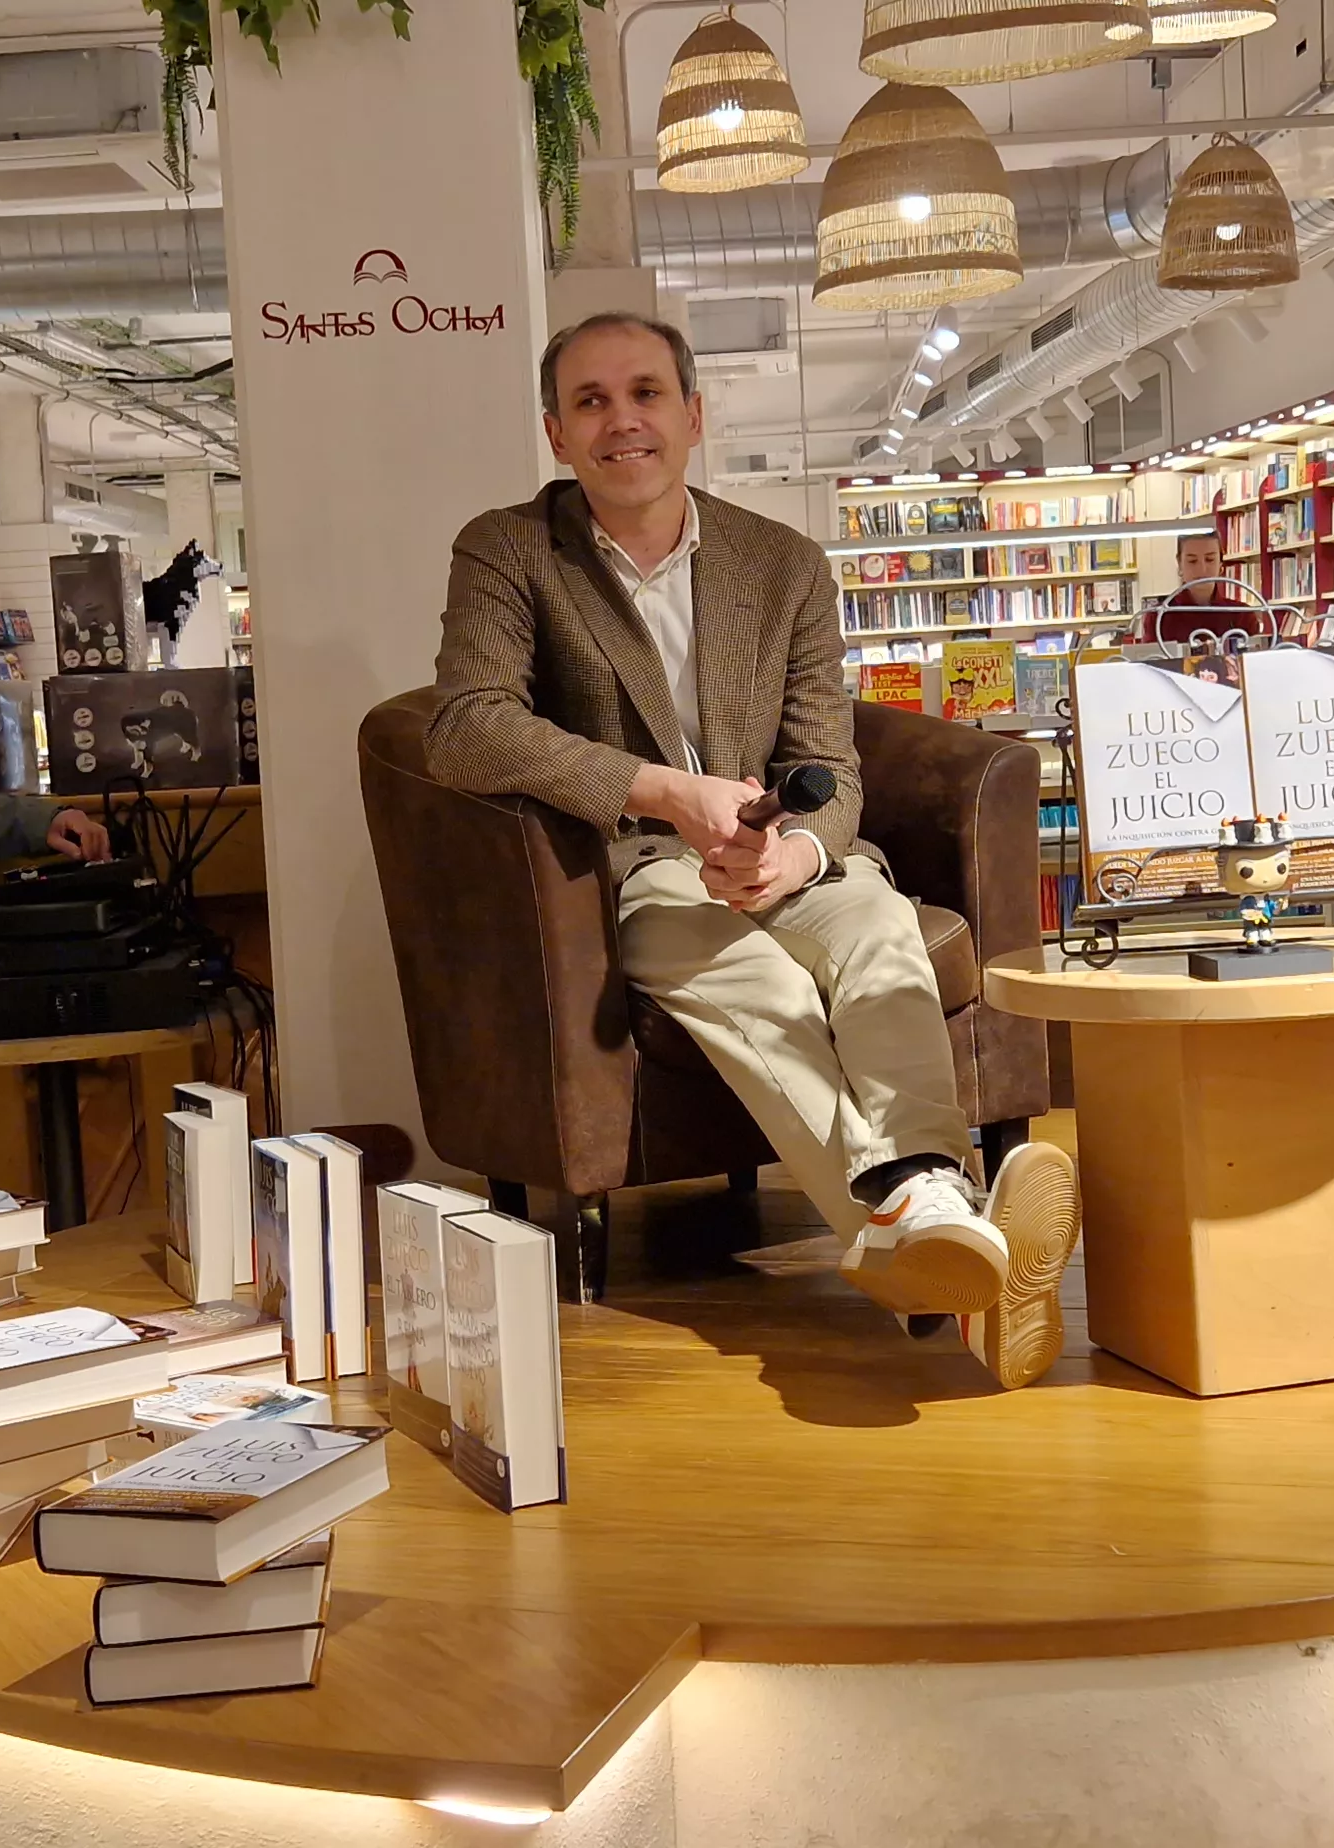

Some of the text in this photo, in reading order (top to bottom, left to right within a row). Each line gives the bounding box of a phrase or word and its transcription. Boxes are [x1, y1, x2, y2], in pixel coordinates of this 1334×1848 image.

[962, 655, 1003, 669] CONSTI
[973, 668, 1008, 690] XXL
[876, 690, 908, 701] LPAC
[1128, 708, 1195, 737] LUIS
[1106, 737, 1220, 770] ZUECO
[1155, 771, 1177, 789] EL
[1110, 789, 1225, 830] JUICIO
[392, 1209, 419, 1241] LUIS
[387, 1236, 430, 1274] ZUECO
[454, 1240, 480, 1272] LUIS
[34, 1322, 94, 1339] LUIS
[223, 1438, 307, 1451] LUIS
[175, 1446, 304, 1464] ZUECO
[133, 1465, 267, 1484] JUICIO
[208, 1461, 229, 1470] EL
